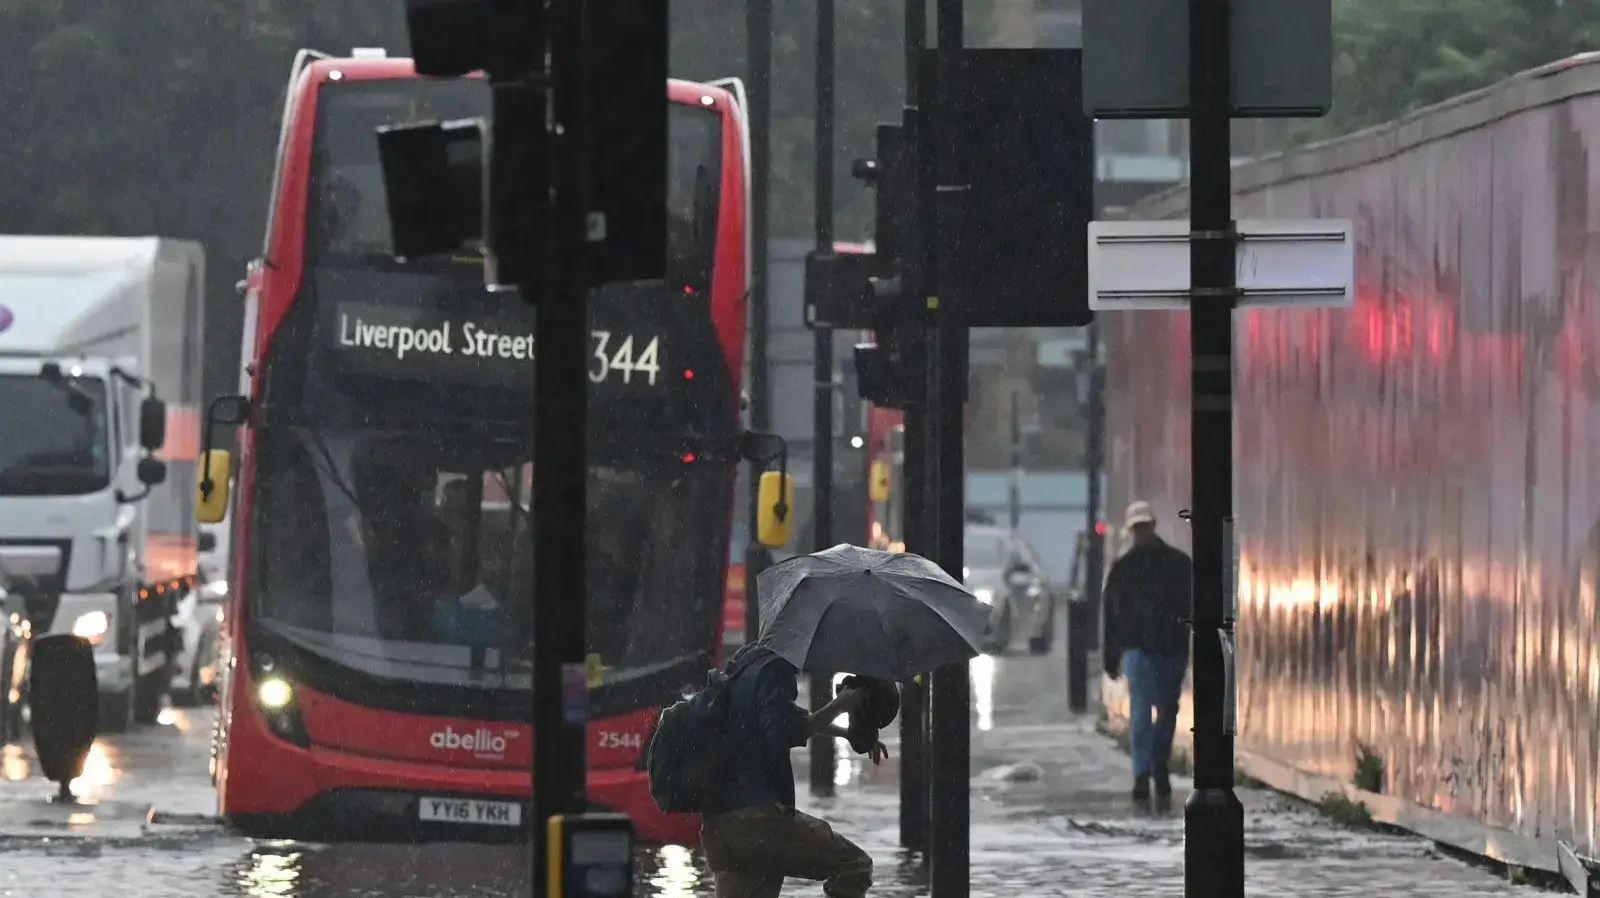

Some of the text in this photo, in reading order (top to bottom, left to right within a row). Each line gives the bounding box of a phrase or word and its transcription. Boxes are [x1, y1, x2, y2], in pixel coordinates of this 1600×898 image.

[340, 313, 535, 360] Liverpool Street
[588, 330, 660, 386] 344
[430, 726, 505, 752] abellio
[598, 731, 641, 748] 2544
[431, 801, 510, 821] YY16 YKH
